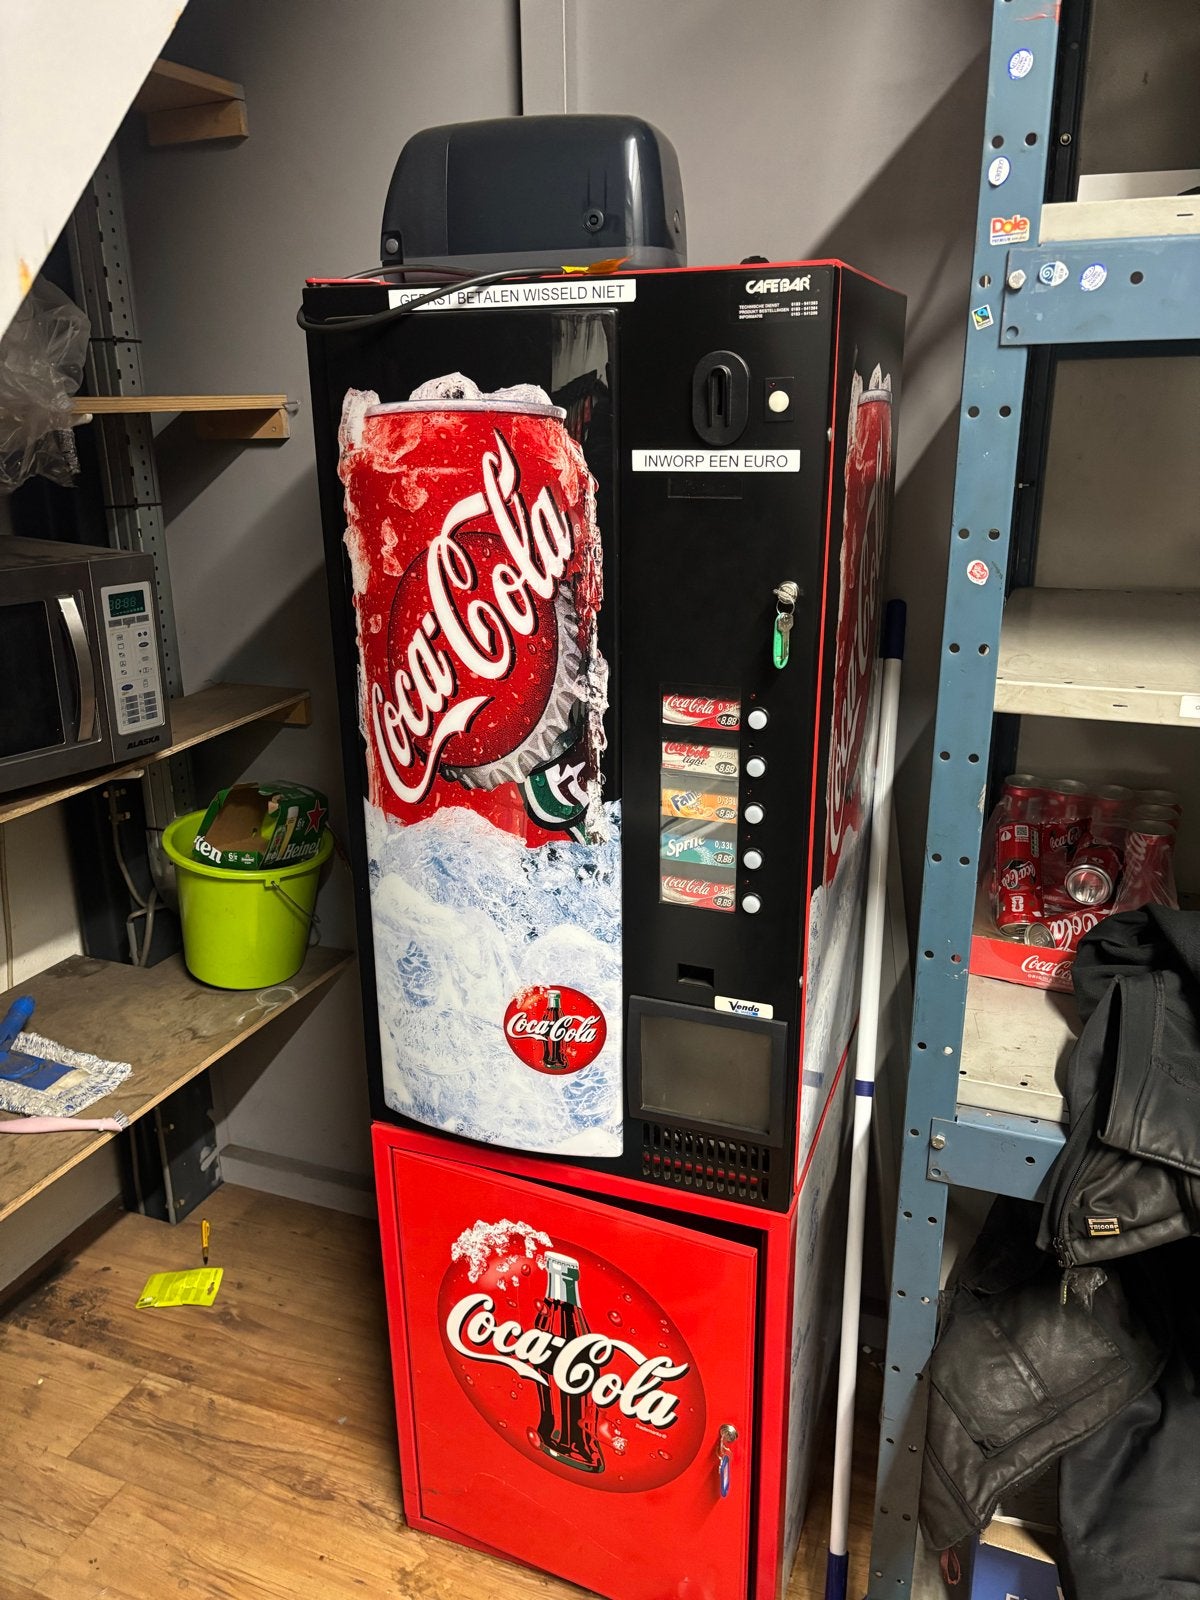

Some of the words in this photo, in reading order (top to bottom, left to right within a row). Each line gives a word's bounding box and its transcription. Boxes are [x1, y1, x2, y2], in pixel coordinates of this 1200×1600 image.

[992, 216, 1028, 234] Dole
[458, 290, 520, 304] BETALEN
[523, 286, 588, 302] WISSELD
[592, 285, 625, 299] NIET
[644, 455, 705, 467] INWORP
[709, 455, 739, 467] EEN
[744, 455, 788, 467] EURO
[372, 428, 573, 804] Coca-Cola
[666, 692, 714, 714] Coca-Cola
[127, 735, 160, 750] ALASKA
[664, 876, 710, 895] Coca-Cola
[728, 1001, 760, 1012] Vendo
[506, 1012, 600, 1042] Coca-Cola
[446, 1293, 689, 1427] Coca-Cola
